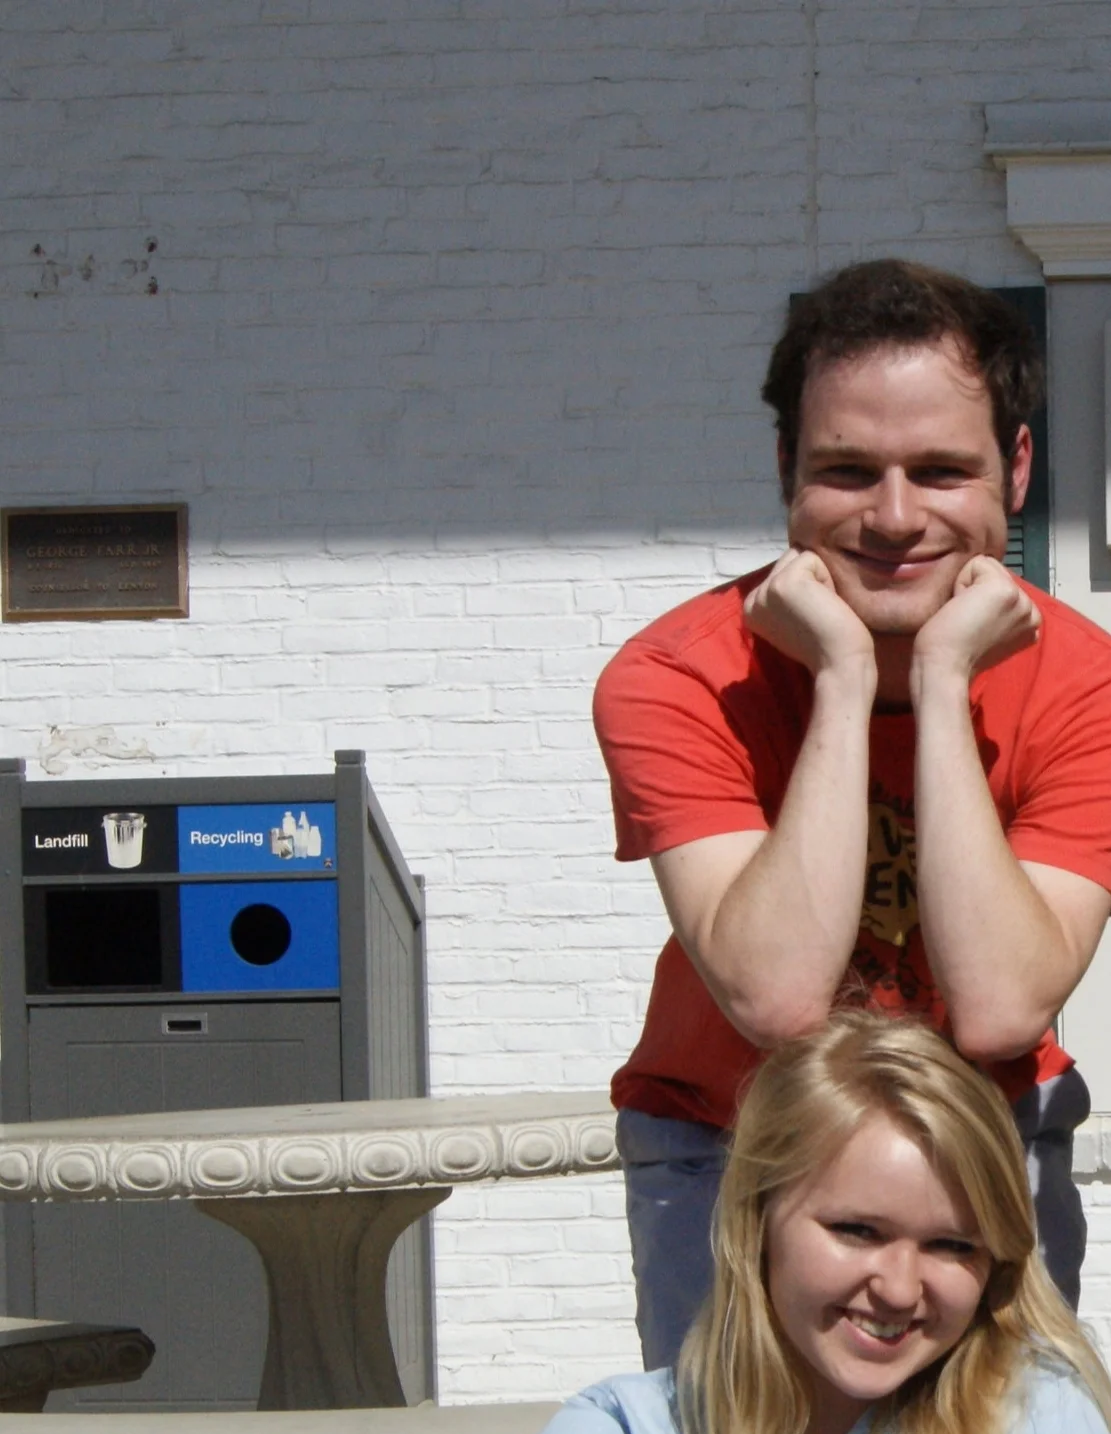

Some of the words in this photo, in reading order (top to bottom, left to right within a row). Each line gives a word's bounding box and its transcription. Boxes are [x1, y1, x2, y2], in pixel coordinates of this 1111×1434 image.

[26, 545, 88, 558] GEORGE
[97, 543, 138, 557] FARR
[35, 833, 88, 849] Landfill
[190, 830, 264, 848] Recycling
